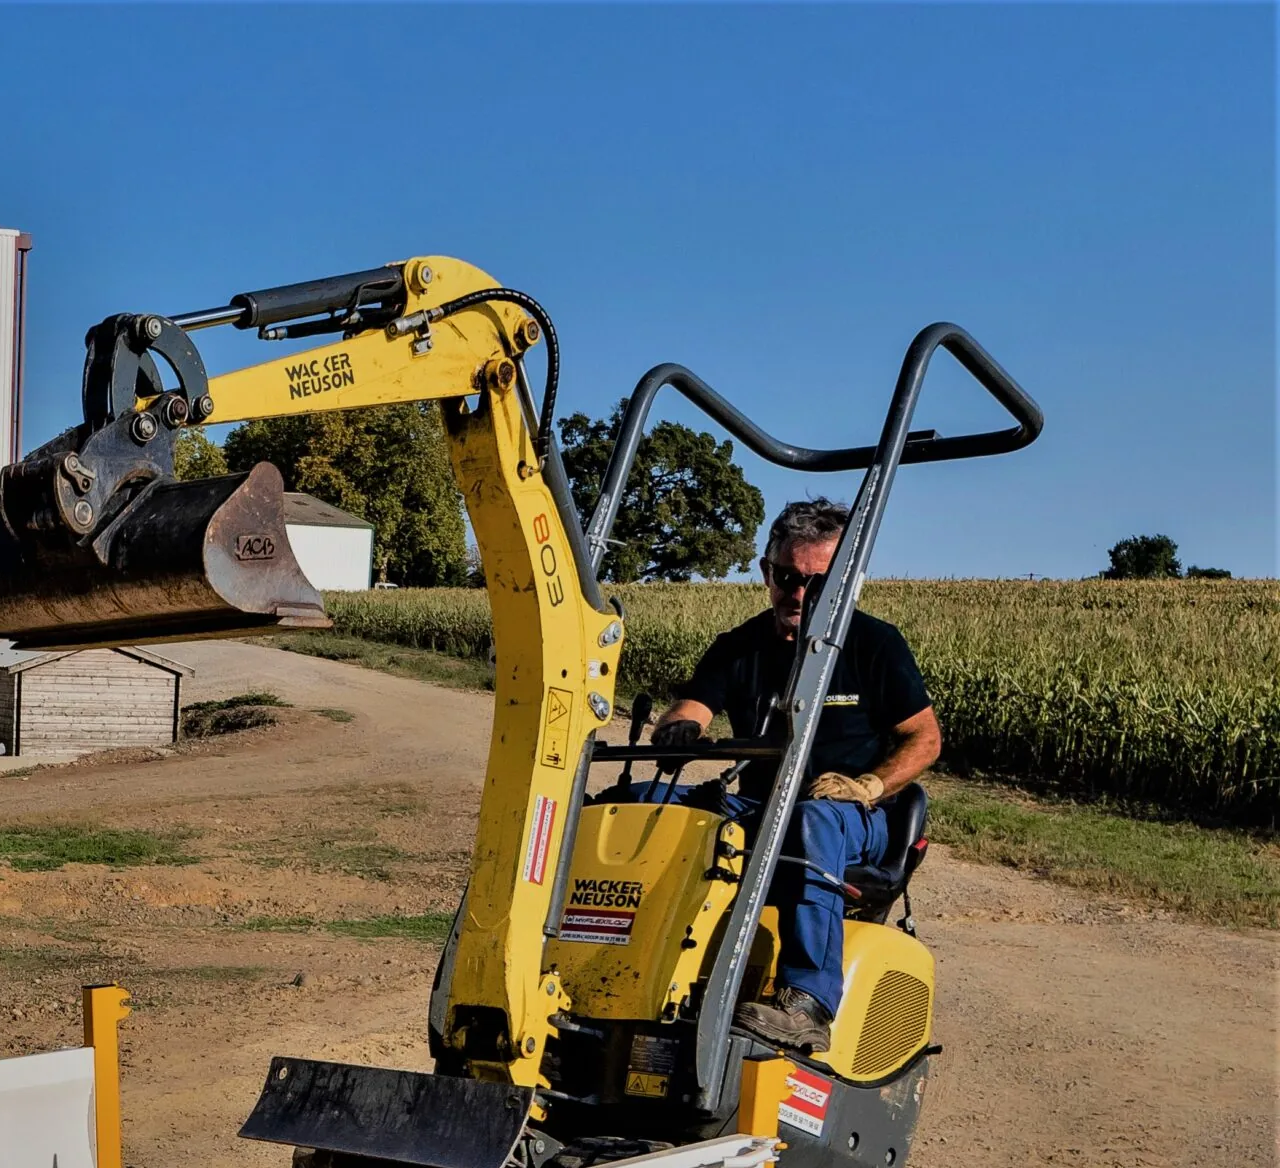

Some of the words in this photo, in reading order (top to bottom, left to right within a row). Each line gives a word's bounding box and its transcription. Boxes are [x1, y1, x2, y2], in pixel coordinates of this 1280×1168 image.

[288, 369, 355, 400] NEUSON
[533, 513, 564, 607] 803
[825, 694, 860, 702] OURDON
[574, 879, 643, 895] WACKER
[569, 892, 641, 908] NEUSON
